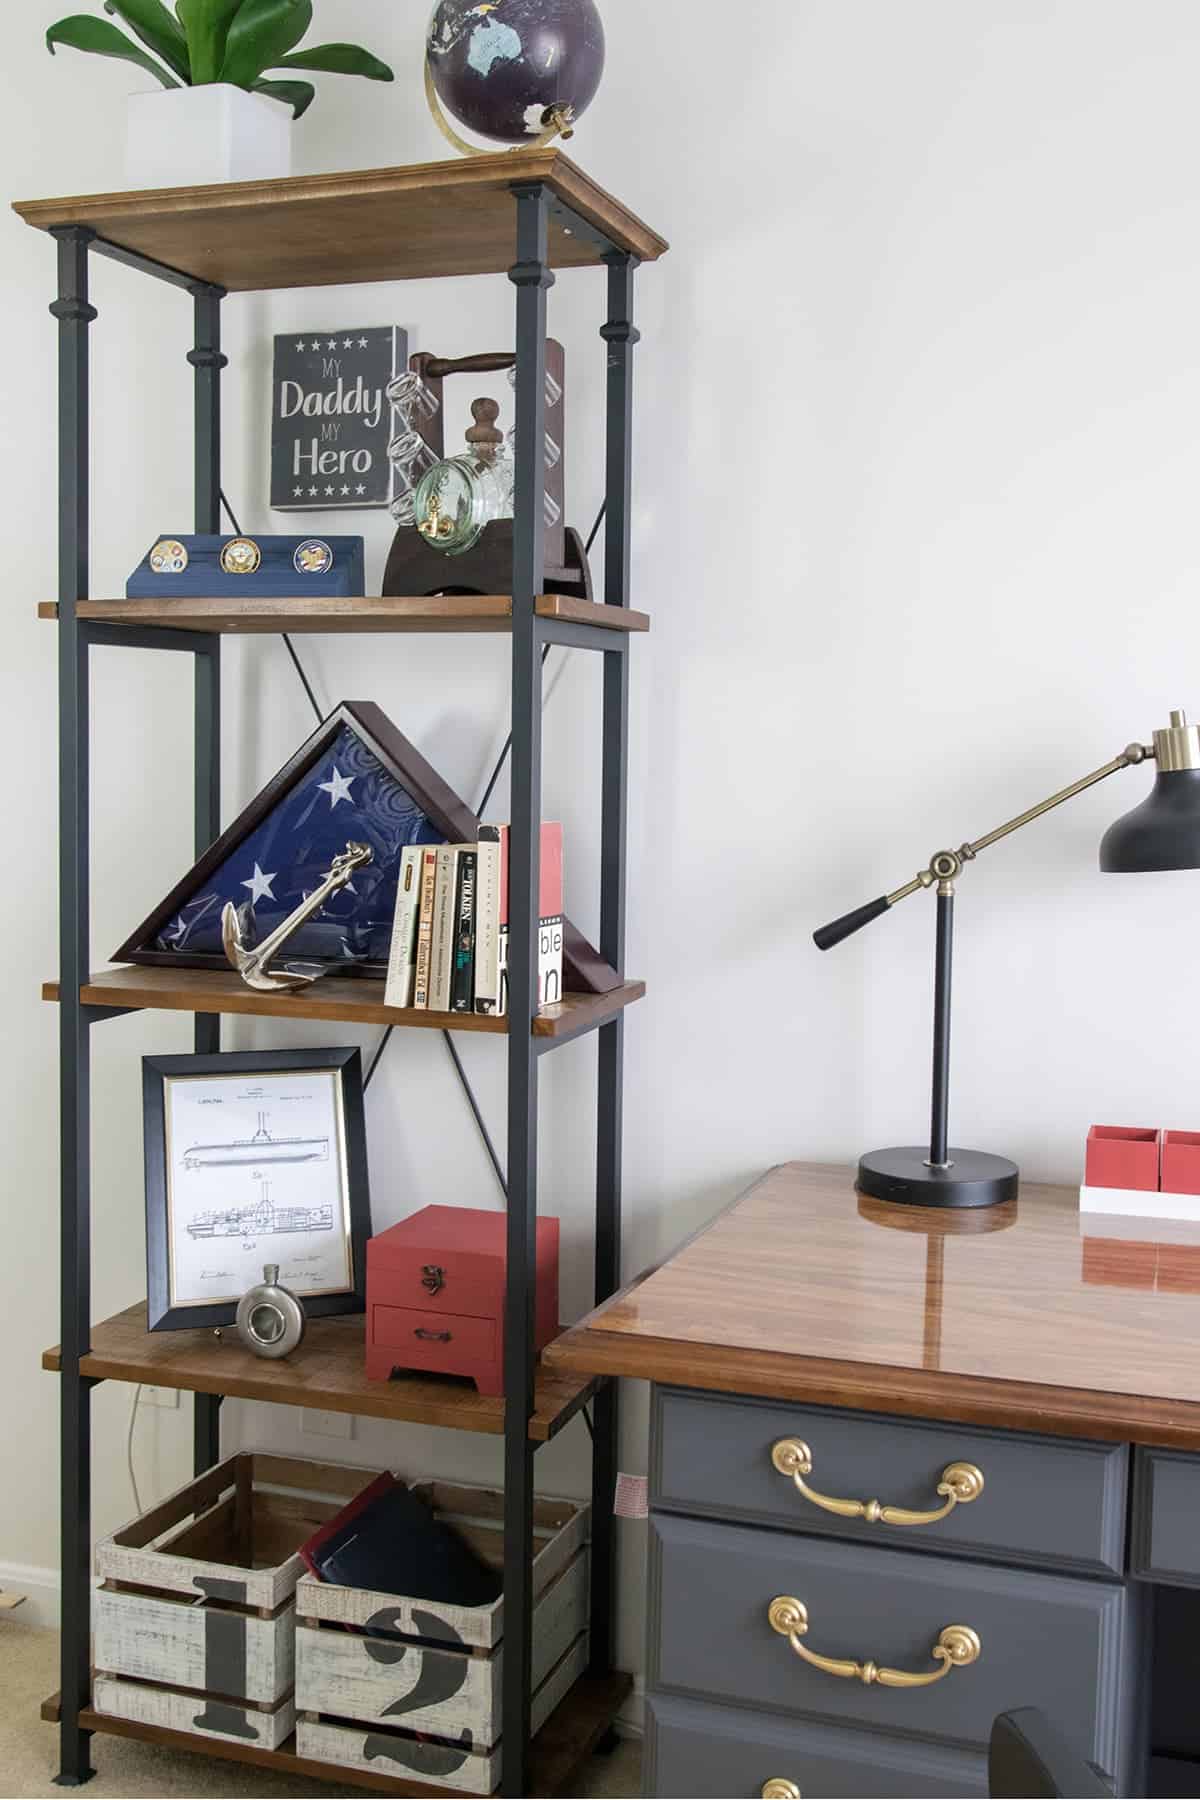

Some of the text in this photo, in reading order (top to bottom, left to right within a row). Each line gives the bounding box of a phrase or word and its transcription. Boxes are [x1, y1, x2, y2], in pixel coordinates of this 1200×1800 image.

[322, 358, 341, 378] MY
[280, 376, 382, 428] Daddy
[321, 424, 341, 441] MY
[293, 438, 372, 476] Hero
[461, 879, 472, 921] TOLKIEN
[541, 928, 561, 955] ble
[193, 1576, 260, 1738] 1
[363, 1607, 473, 1776] 2
